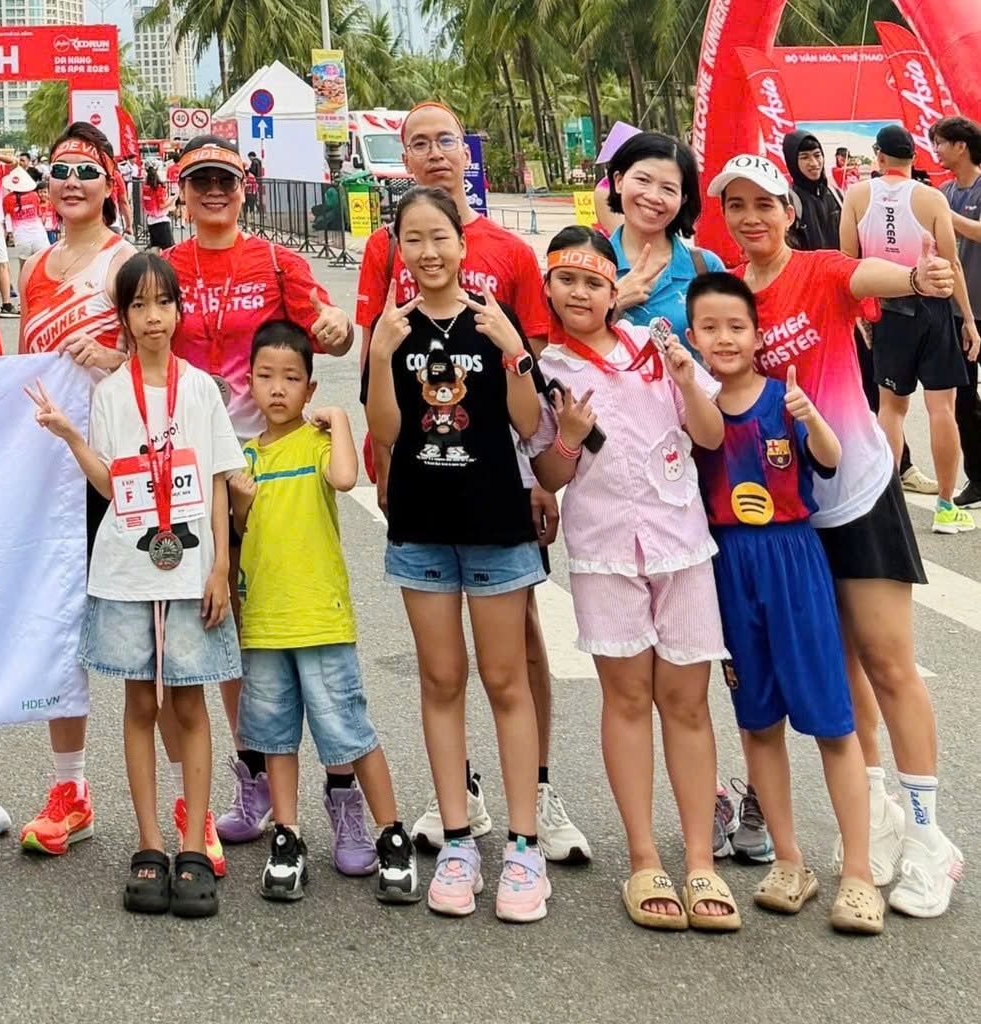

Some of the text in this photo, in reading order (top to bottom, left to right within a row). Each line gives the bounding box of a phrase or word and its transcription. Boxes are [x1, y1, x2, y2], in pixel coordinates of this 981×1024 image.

[884, 207, 896, 245] PACER
[36, 304, 88, 353] RUNNER
[761, 328, 822, 370] FASTER
[125, 491, 133, 503] F
